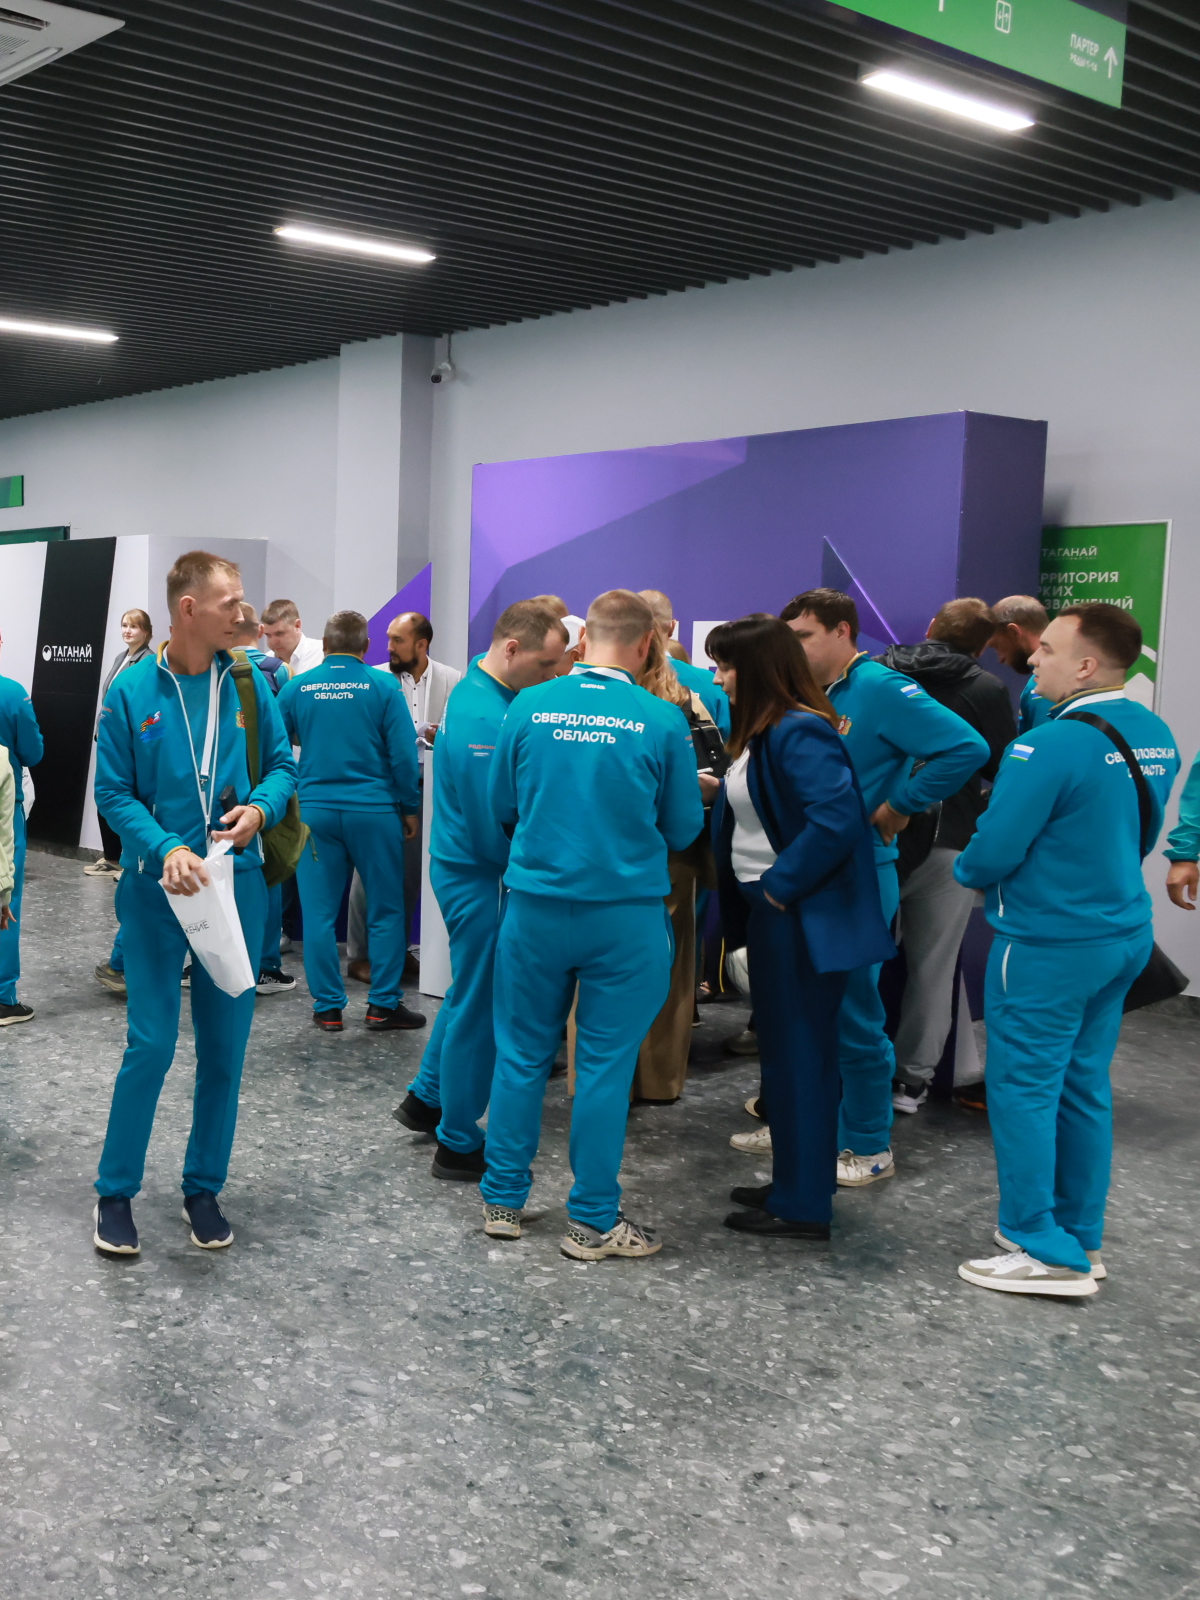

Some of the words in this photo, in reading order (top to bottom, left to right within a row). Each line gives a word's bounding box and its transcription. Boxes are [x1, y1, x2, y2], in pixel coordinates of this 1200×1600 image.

[1071, 33, 1099, 56] ПАРТЕР
[1041, 545, 1098, 558] ТАГАНАЙ
[1040, 571, 1120, 584] РРИТОРИЯ
[1038, 585, 1075, 597] КИХ
[52, 643, 93, 658] ТАГАНАЙ
[300, 682, 370, 693] СВЕРДЛОВСКАЯ
[313, 691, 354, 700] ОБЛАСТЬ
[531, 712, 646, 734] СВЕРДЛОВСКАЯ
[552, 728, 617, 744] ОБЛАСТЬ
[1104, 747, 1176, 765] СВДЛОВСКАЯ
[1127, 764, 1167, 778] ЛАСТЬ
